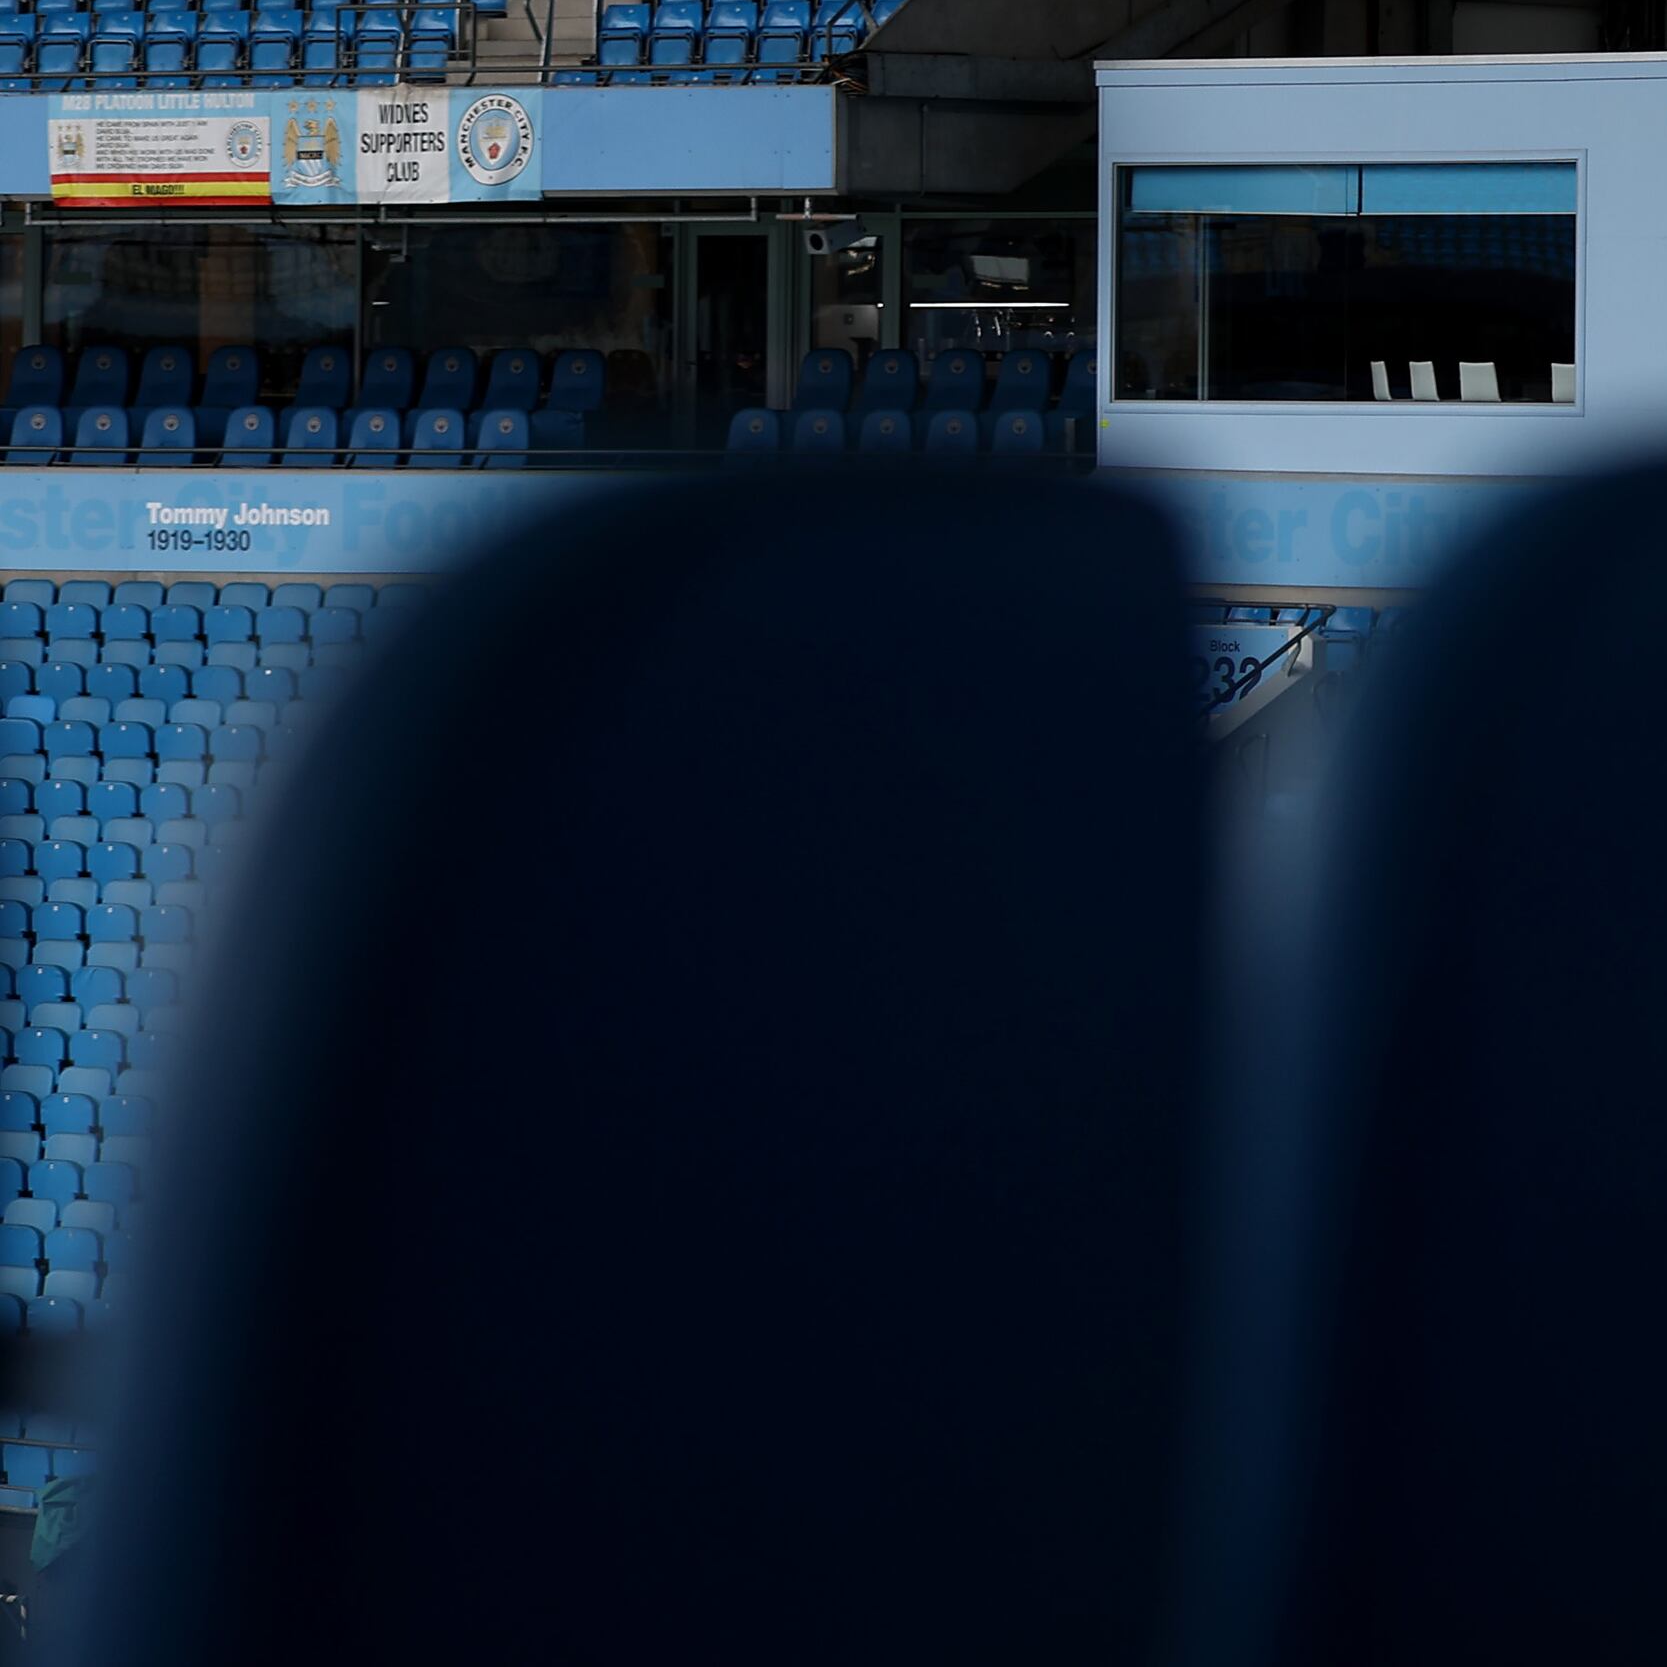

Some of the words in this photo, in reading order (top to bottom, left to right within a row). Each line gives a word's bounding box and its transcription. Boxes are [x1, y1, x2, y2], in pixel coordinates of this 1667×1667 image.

[157, 94, 201, 110] LITTLE
[361, 131, 446, 154] SUPPORTERS
[460, 99, 513, 168] MANCHESTER
[515, 110, 530, 140] CITY
[386, 161, 420, 183] CLUB
[146, 502, 229, 529] Tommy
[234, 502, 331, 526] Johnson
[1209, 639, 1241, 652] Block
